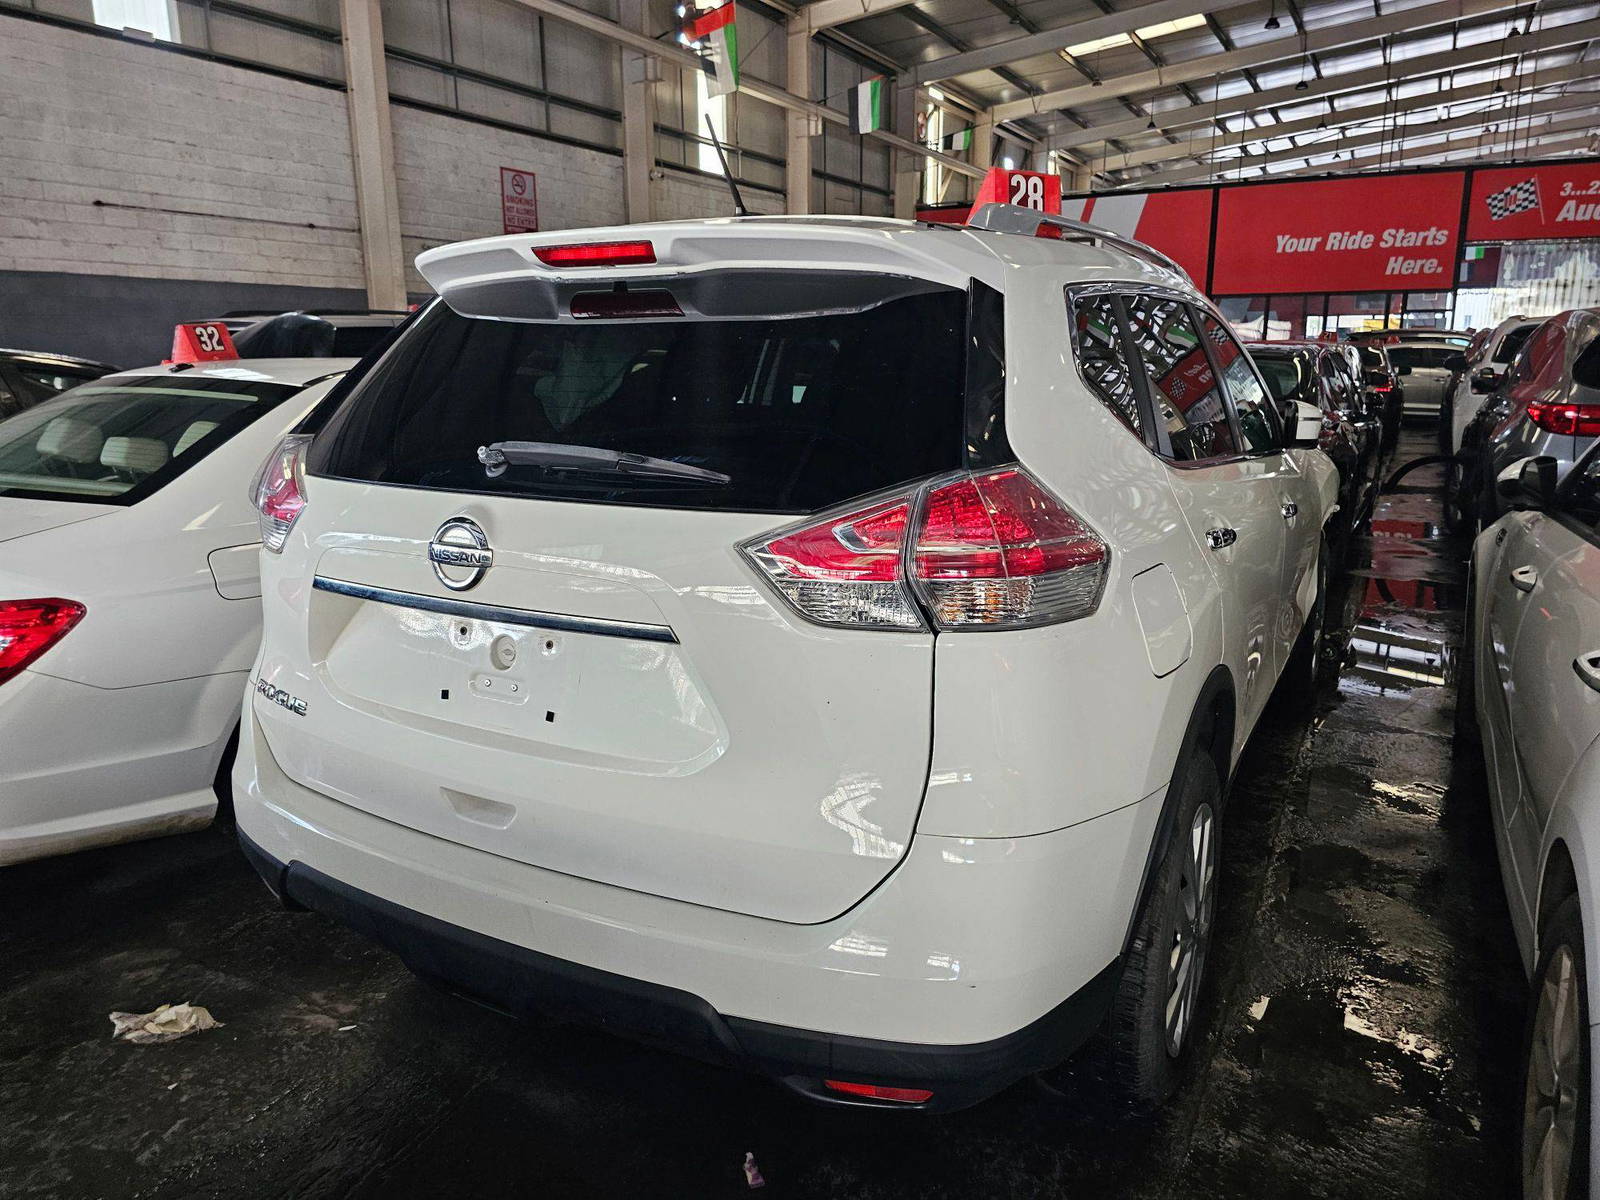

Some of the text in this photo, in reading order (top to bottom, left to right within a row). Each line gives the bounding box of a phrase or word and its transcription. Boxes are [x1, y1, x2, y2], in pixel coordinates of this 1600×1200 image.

[1010, 174, 1043, 211] 28
[1275, 226, 1449, 253] Your Ride Starts
[1384, 256, 1443, 276] Here.
[195, 326, 225, 352] 32
[430, 546, 482, 564] NISSAN
[257, 678, 308, 717] ROGUE
